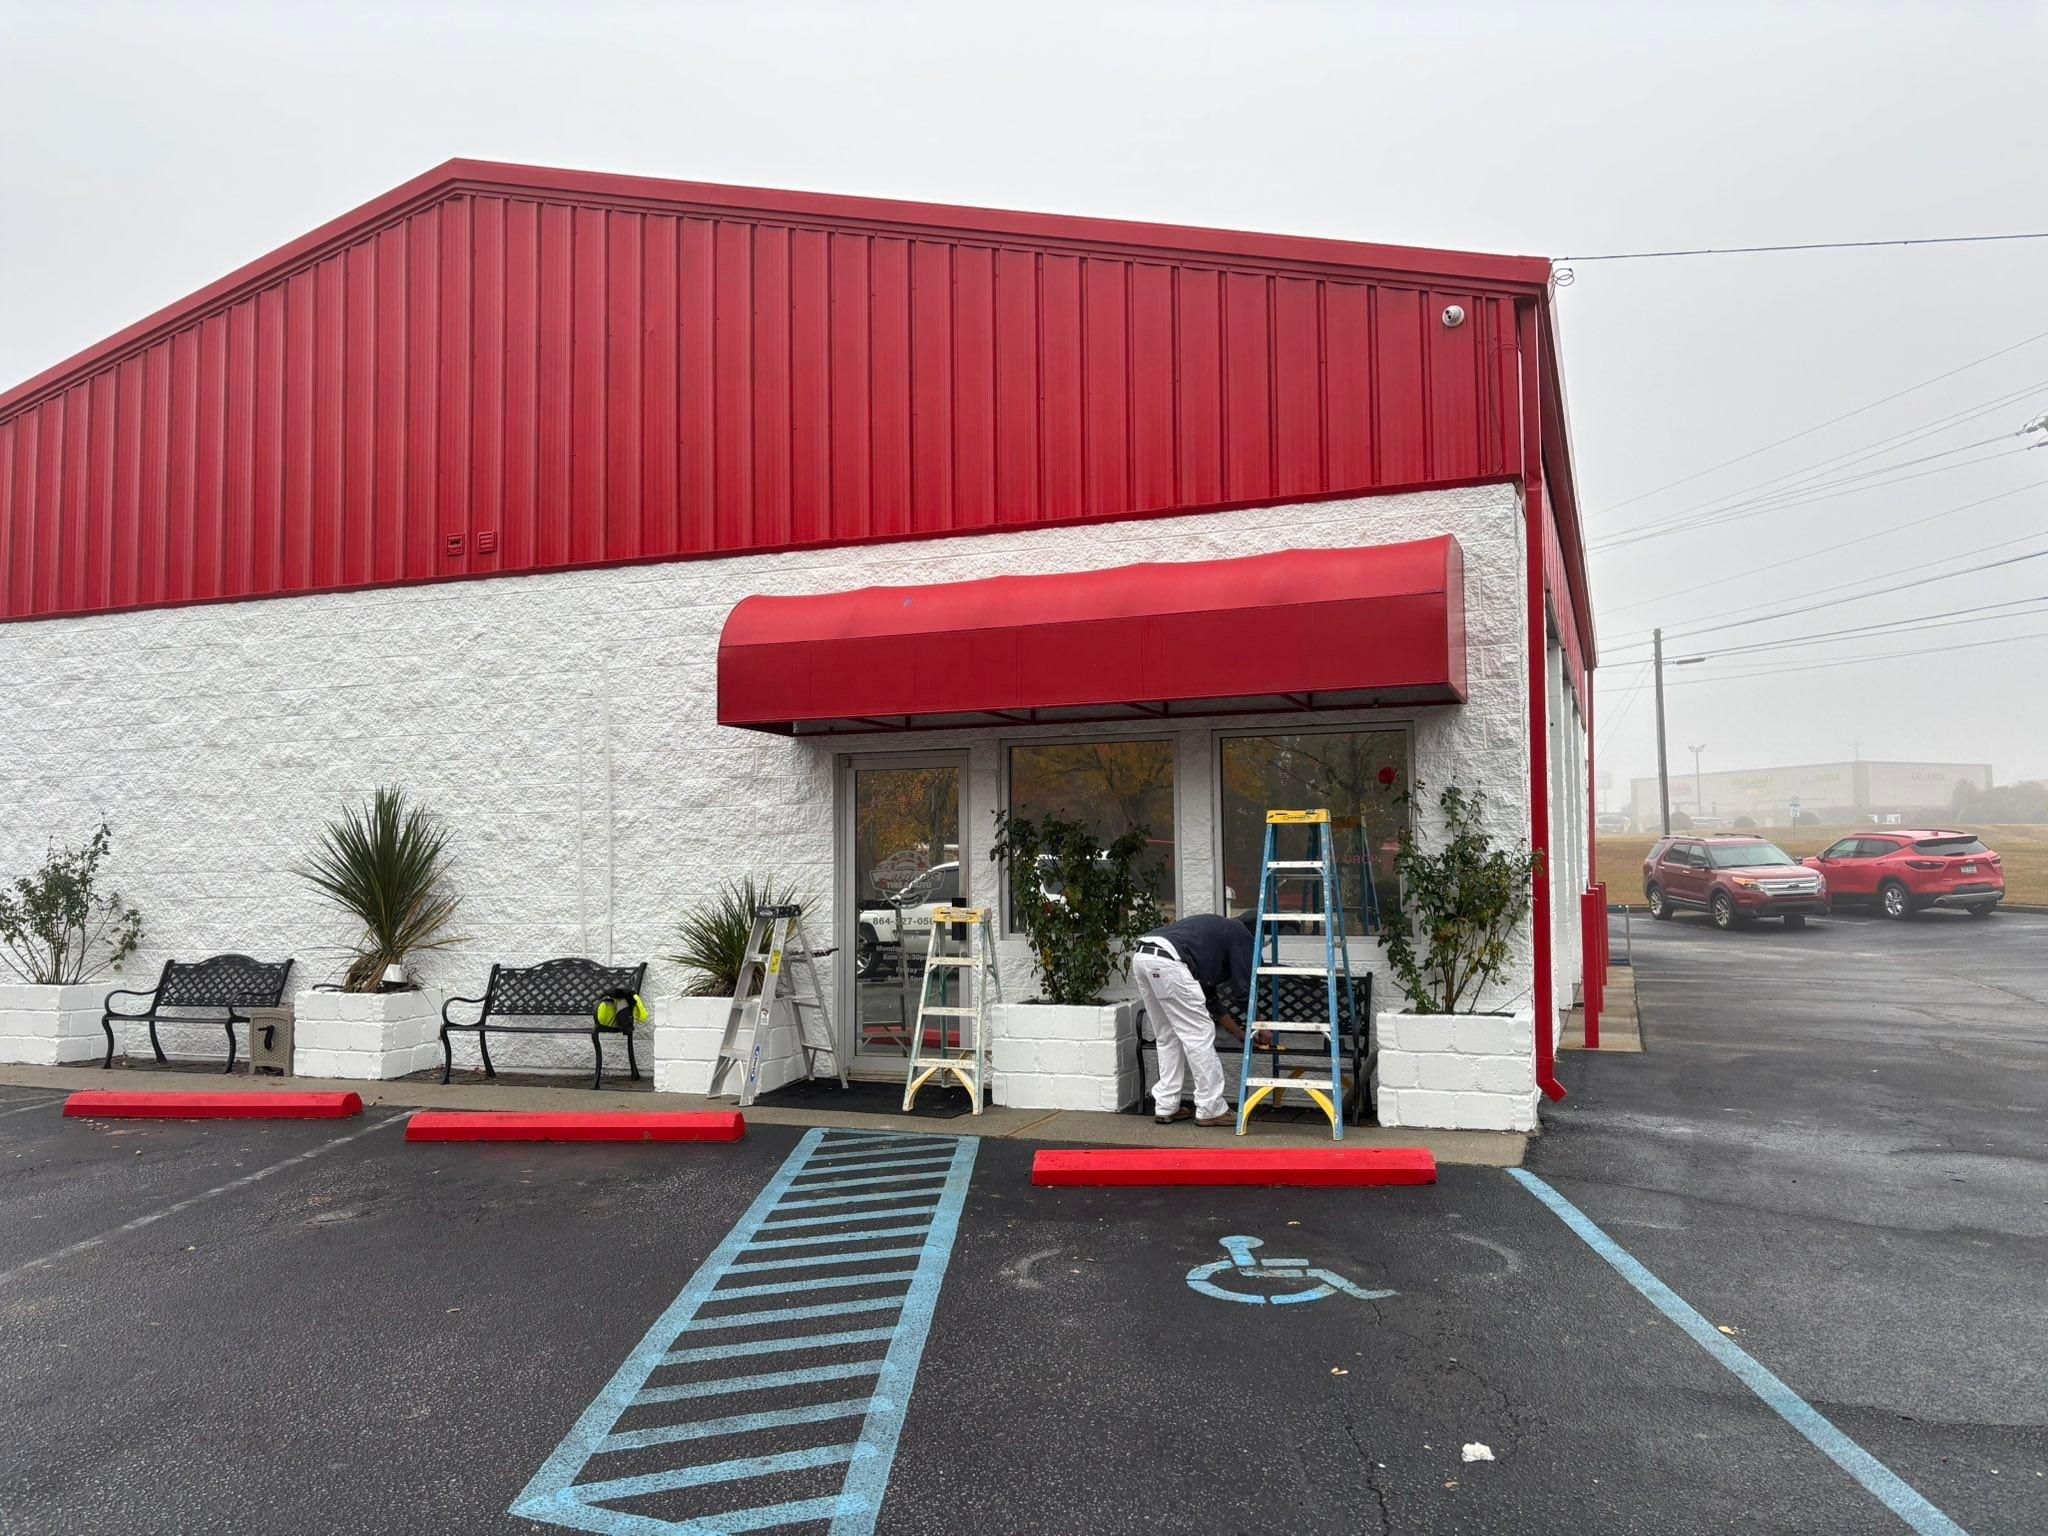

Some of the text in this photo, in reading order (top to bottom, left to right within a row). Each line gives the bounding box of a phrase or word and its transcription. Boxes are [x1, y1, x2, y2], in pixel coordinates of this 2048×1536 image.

[886, 881, 903, 889] TIRE
[911, 881, 932, 889] AUTO
[895, 966, 918, 974] Fray
